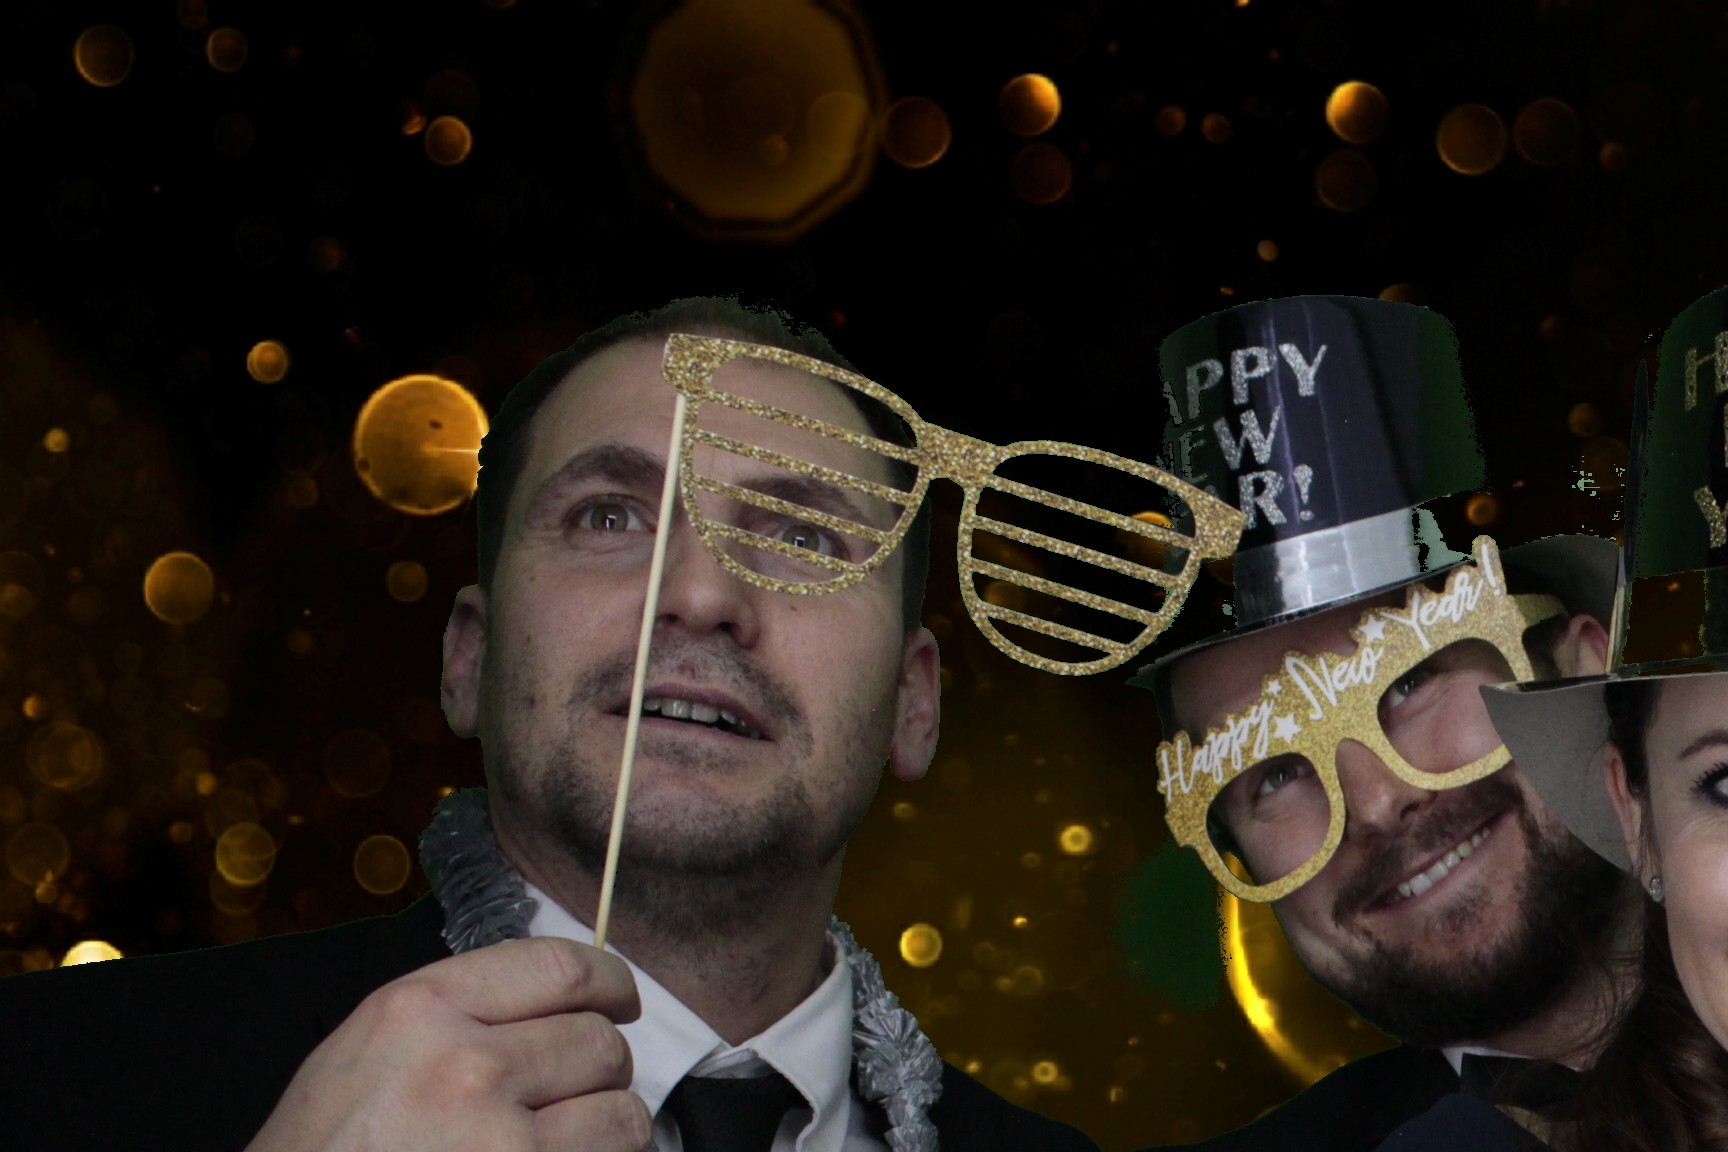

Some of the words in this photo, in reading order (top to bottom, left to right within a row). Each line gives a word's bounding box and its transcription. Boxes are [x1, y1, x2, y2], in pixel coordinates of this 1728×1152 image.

[1164, 342, 1328, 427] PPY
[1159, 698, 1275, 802] Happy
[1284, 646, 1385, 720] New
[1380, 543, 1502, 651] Year!
